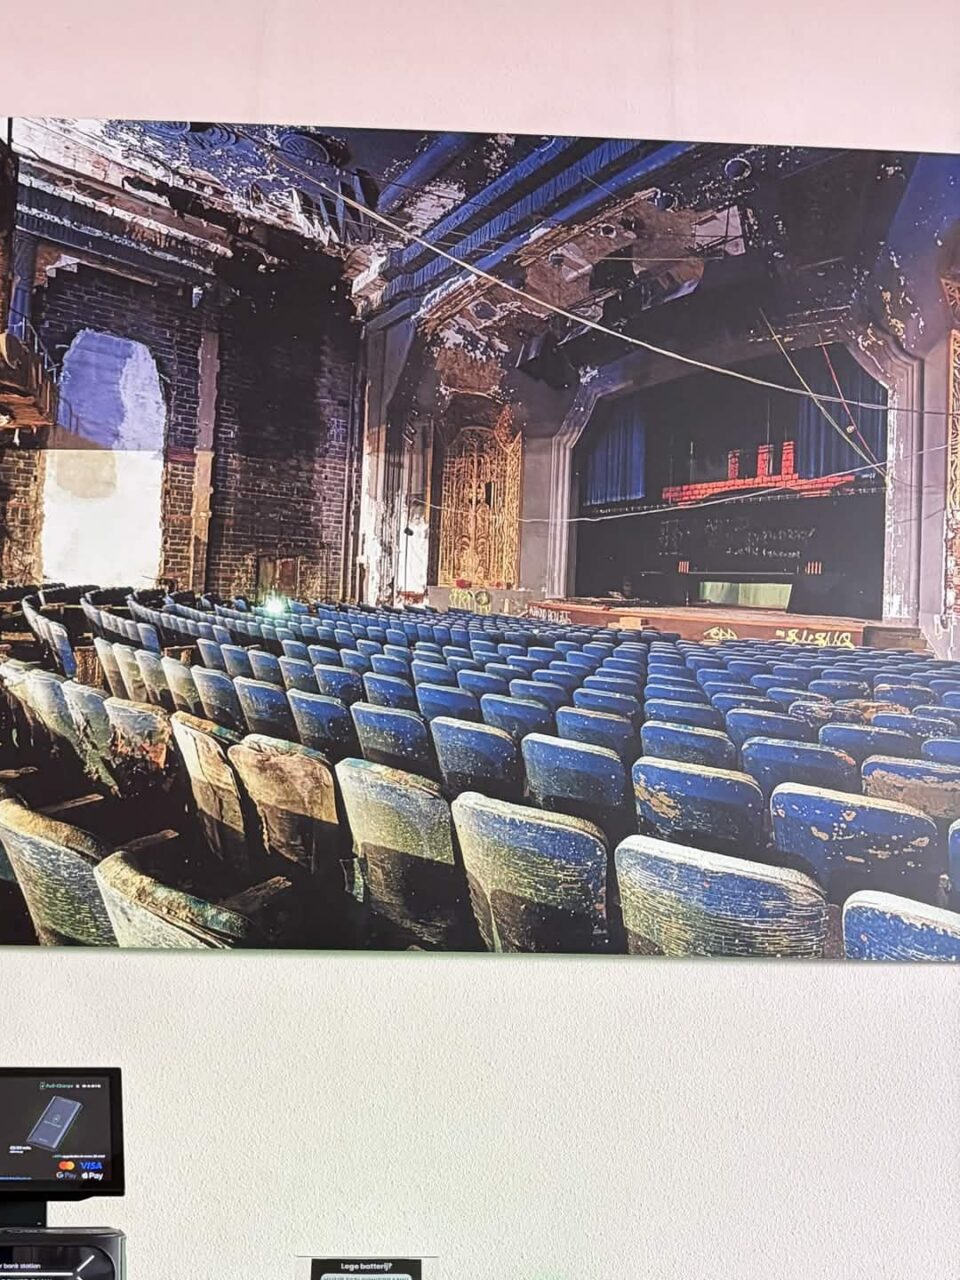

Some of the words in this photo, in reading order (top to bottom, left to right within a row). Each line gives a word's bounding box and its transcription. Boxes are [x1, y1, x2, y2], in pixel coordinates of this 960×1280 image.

[80, 1161, 103, 1170] VISA
[89, 1172, 104, 1181] Pay
[340, 1263, 359, 1271] Lege
